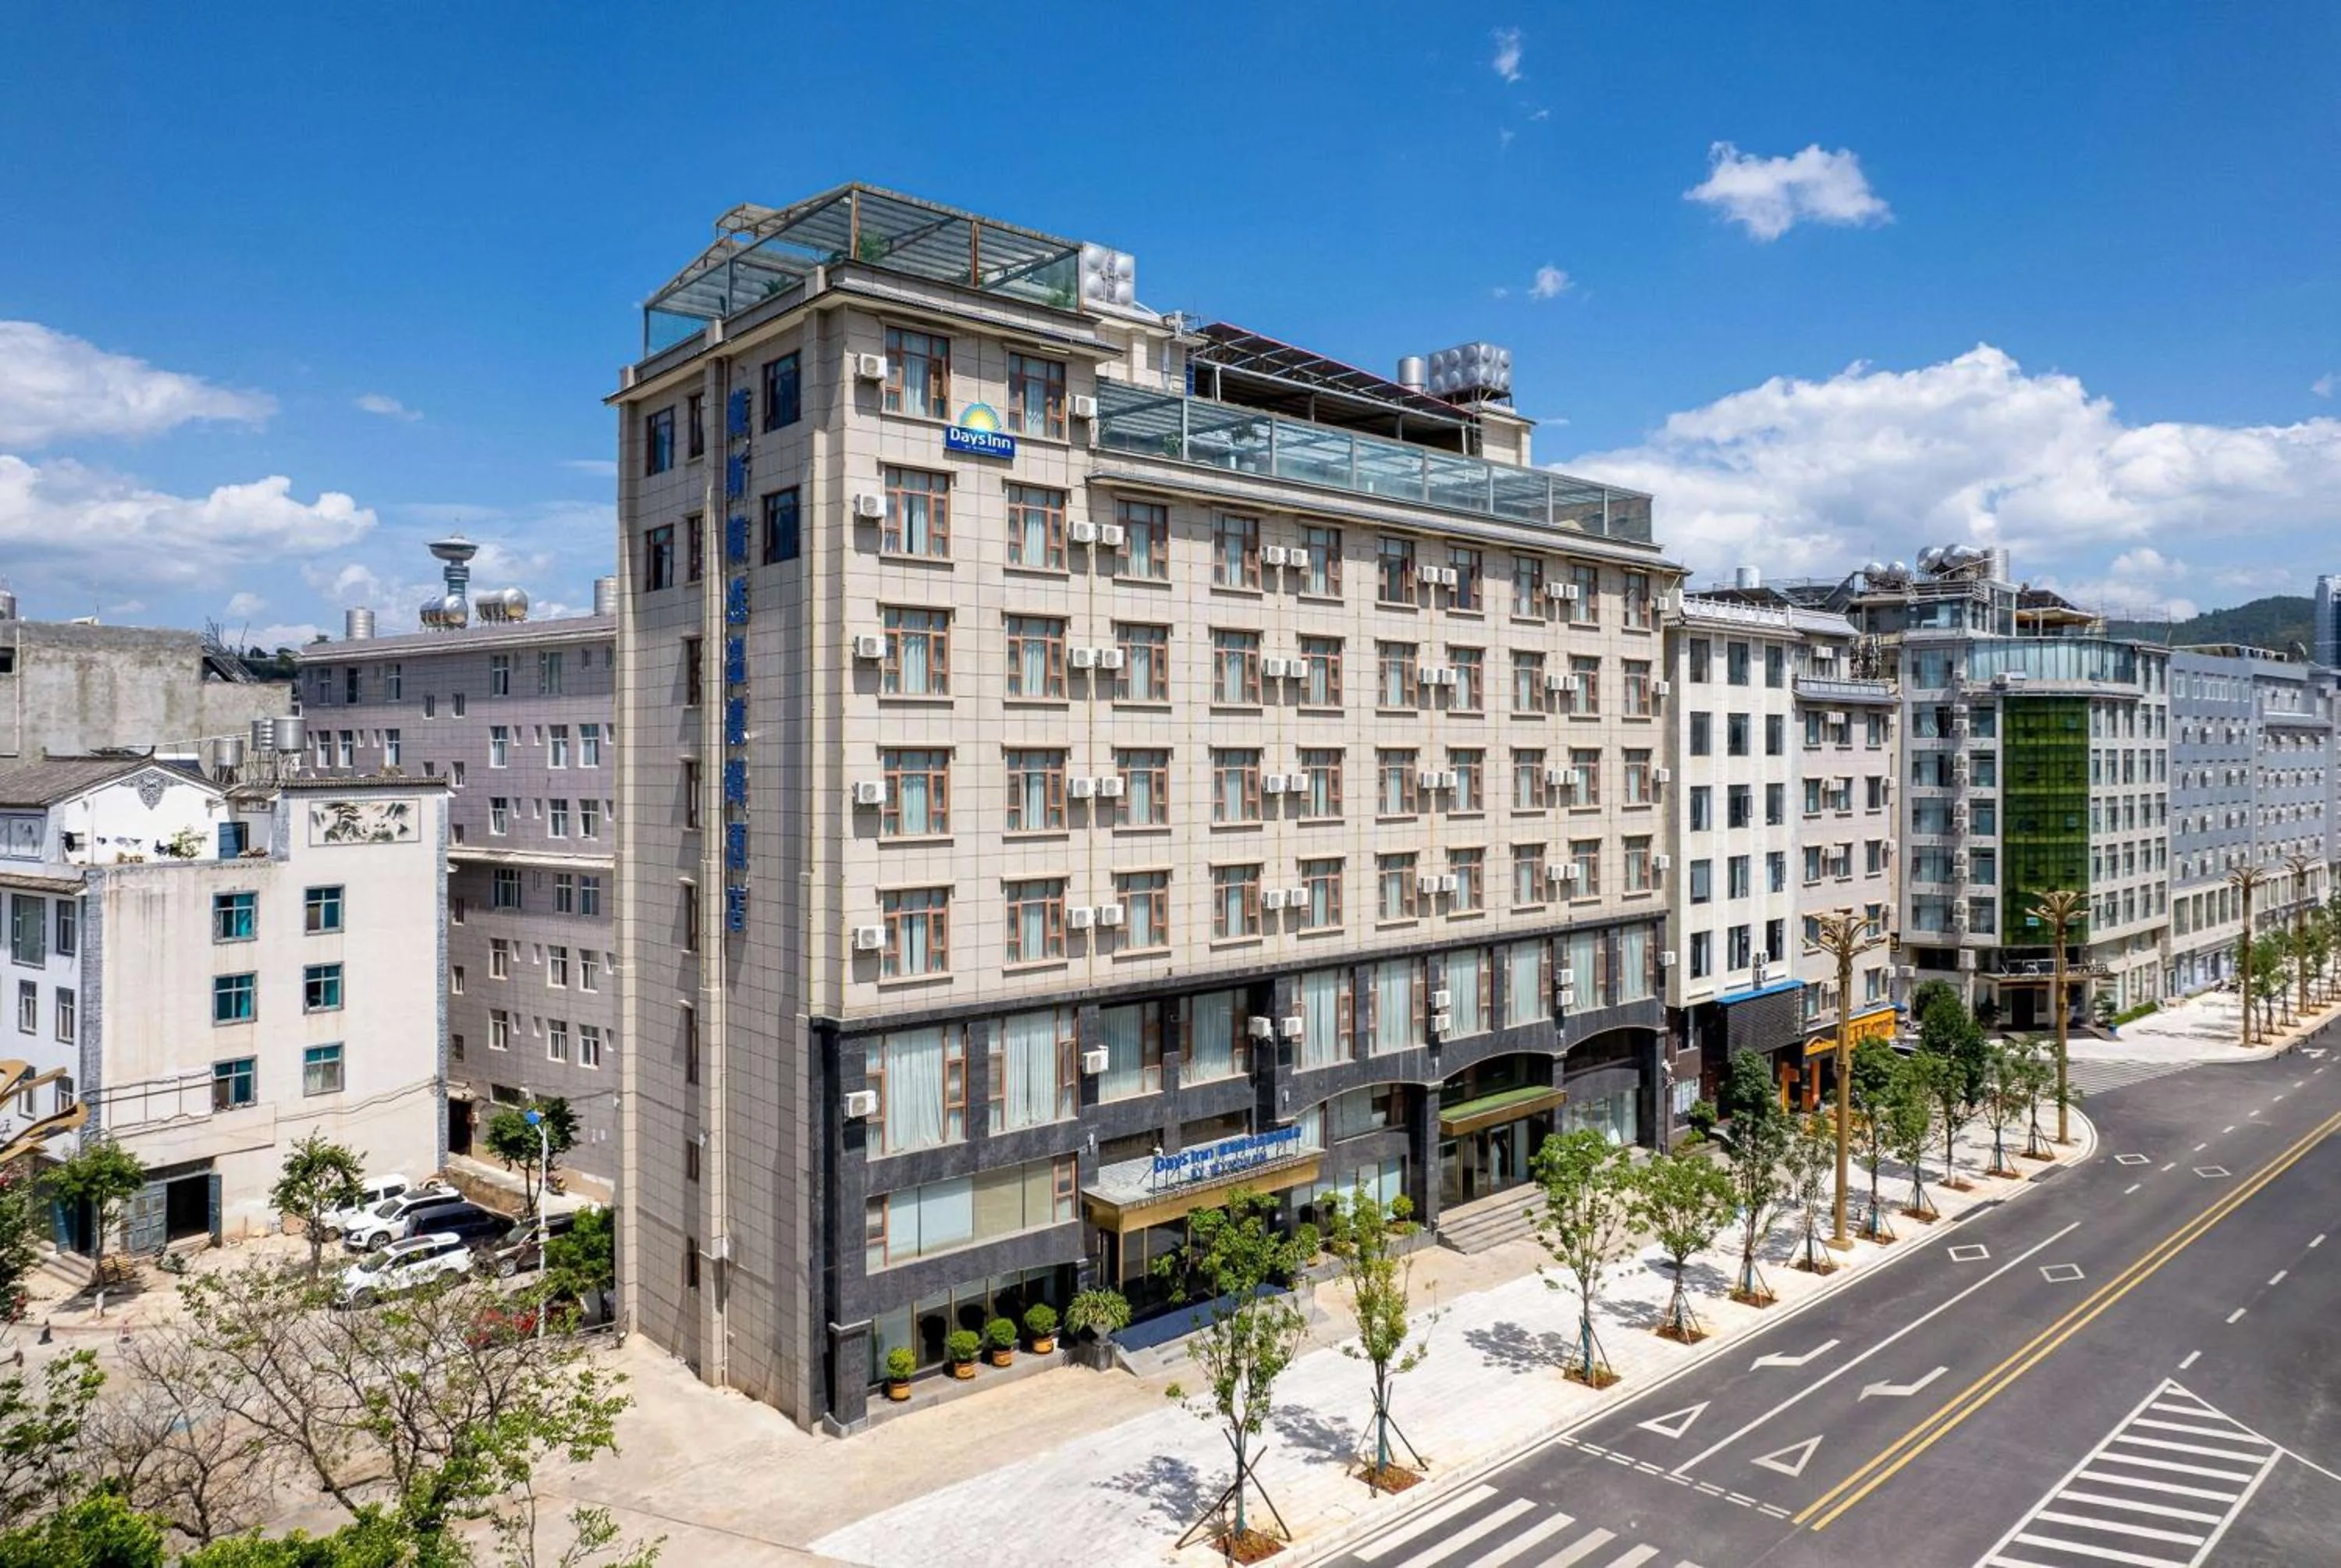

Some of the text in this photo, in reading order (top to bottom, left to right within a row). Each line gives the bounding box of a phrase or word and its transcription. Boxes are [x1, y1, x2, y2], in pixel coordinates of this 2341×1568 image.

[950, 427, 986, 445] Days
[988, 433, 1011, 449] Inn
[1153, 1148, 1214, 1174] Days Inn
